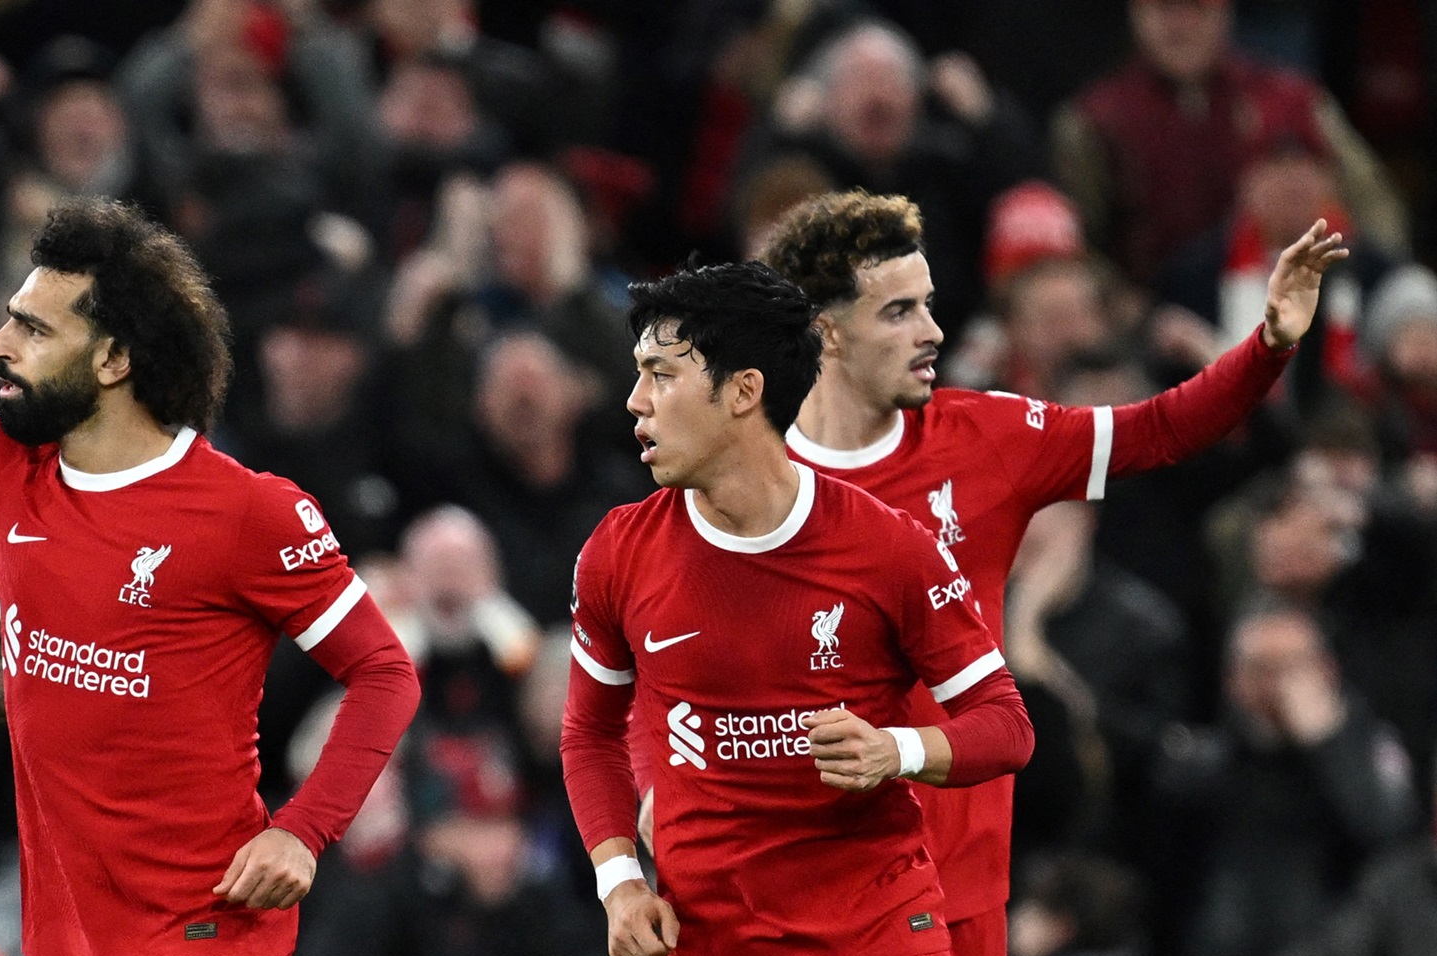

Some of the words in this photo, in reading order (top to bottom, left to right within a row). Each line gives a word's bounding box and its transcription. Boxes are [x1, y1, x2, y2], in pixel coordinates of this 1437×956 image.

[28, 628, 145, 674] standard
[24, 653, 151, 698] chartered
[714, 701, 847, 737] standa
[716, 733, 812, 761] charte
